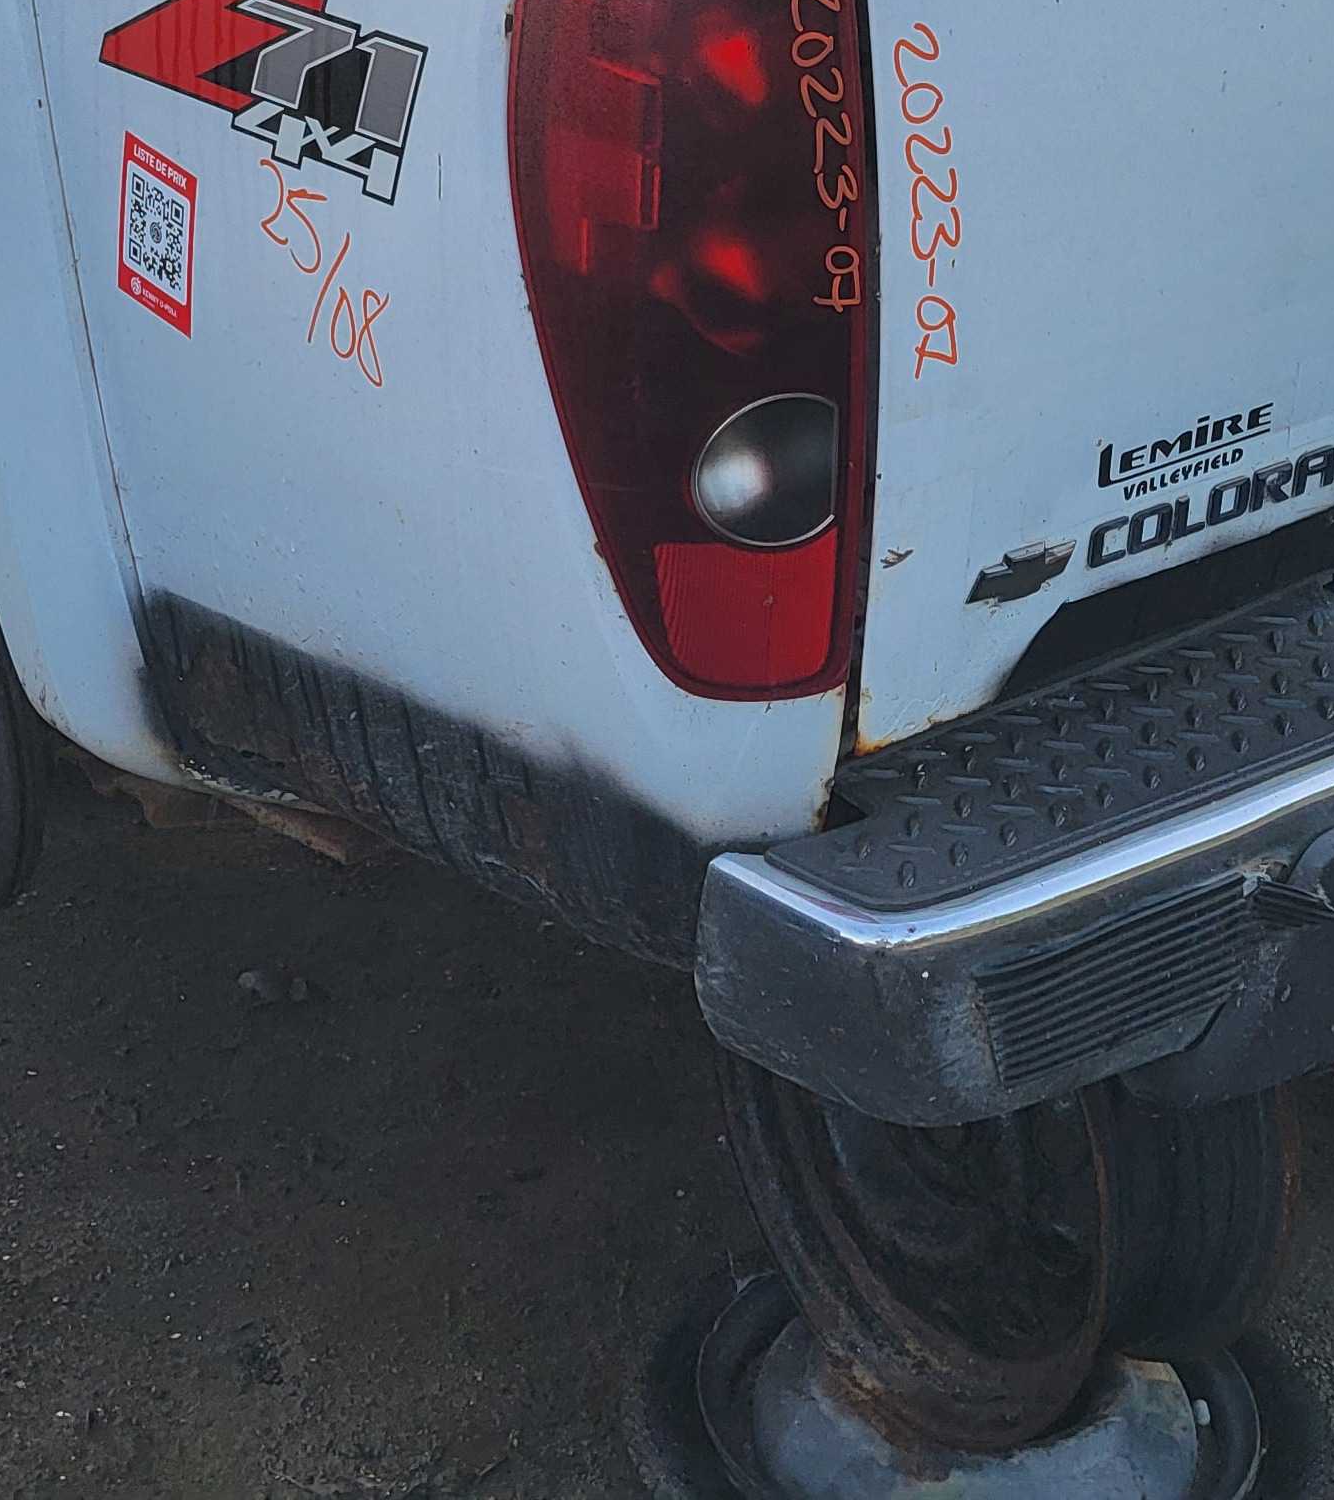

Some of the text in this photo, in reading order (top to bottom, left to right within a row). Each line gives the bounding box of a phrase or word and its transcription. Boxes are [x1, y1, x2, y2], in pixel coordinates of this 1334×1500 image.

[133, 143, 188, 191] LISTE DE PRIX
[894, 23, 960, 380] 20223-07
[1123, 448, 1244, 501] VALLEYFIELD
